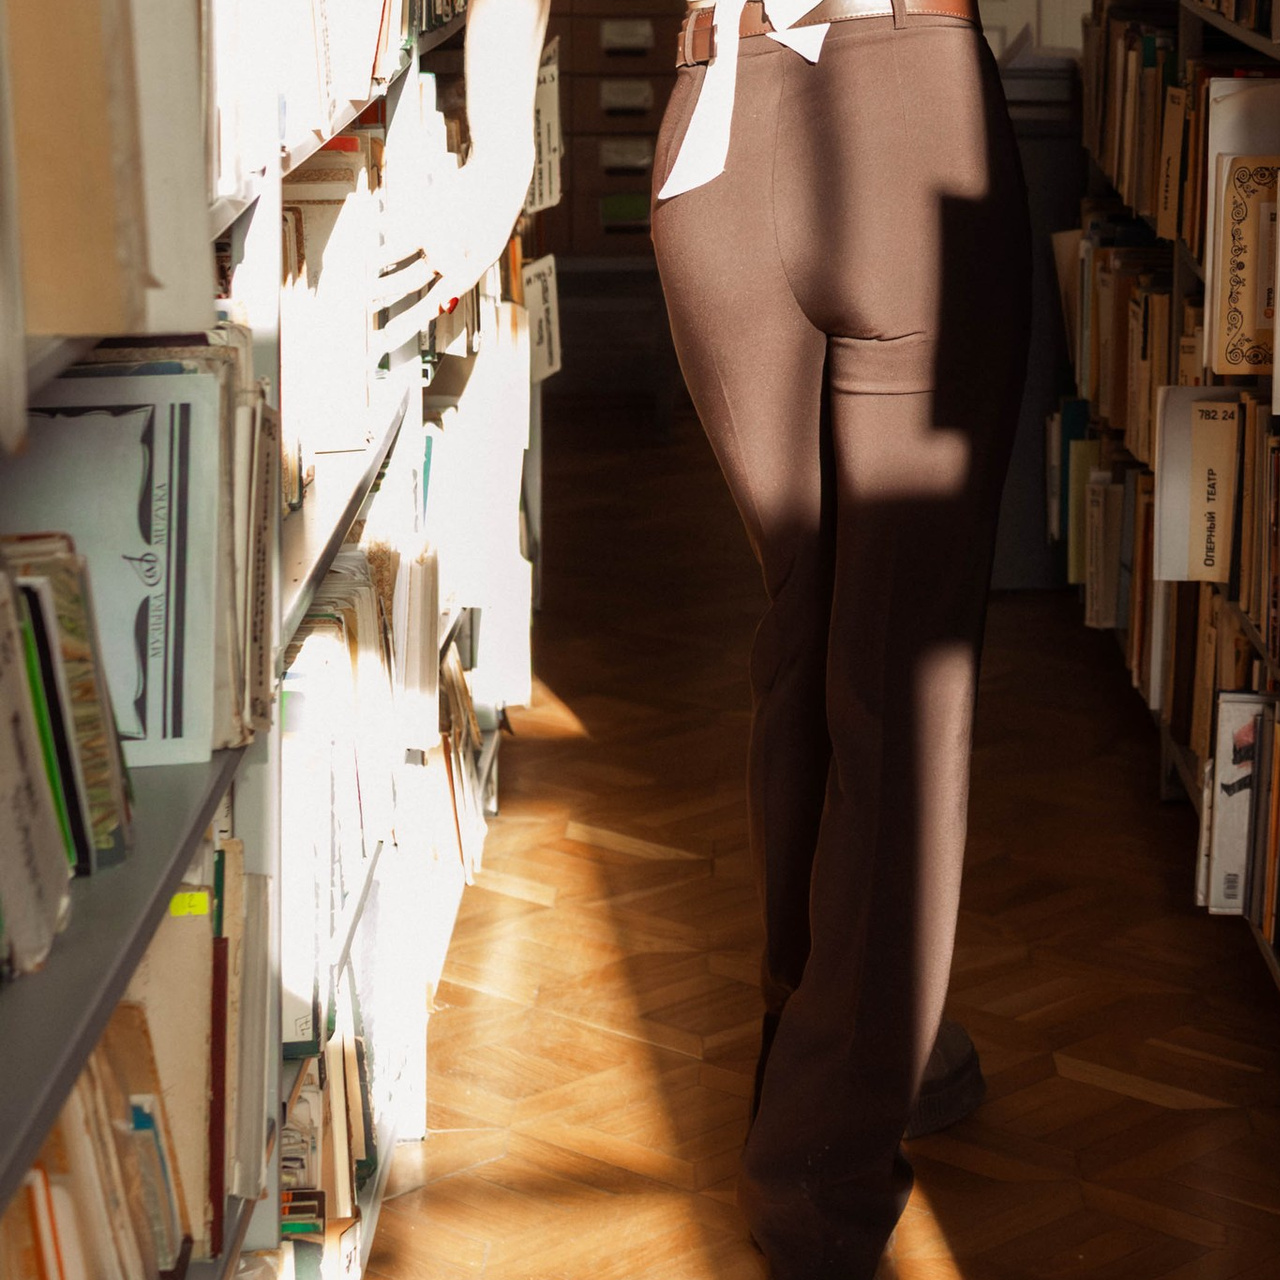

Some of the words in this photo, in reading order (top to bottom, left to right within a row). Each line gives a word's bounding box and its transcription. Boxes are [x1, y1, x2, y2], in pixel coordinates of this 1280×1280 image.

[154, 483, 168, 547] MUZYKA
[1206, 468, 1217, 503] ТЕАТР
[150, 593, 166, 660] МУЗЫКА
